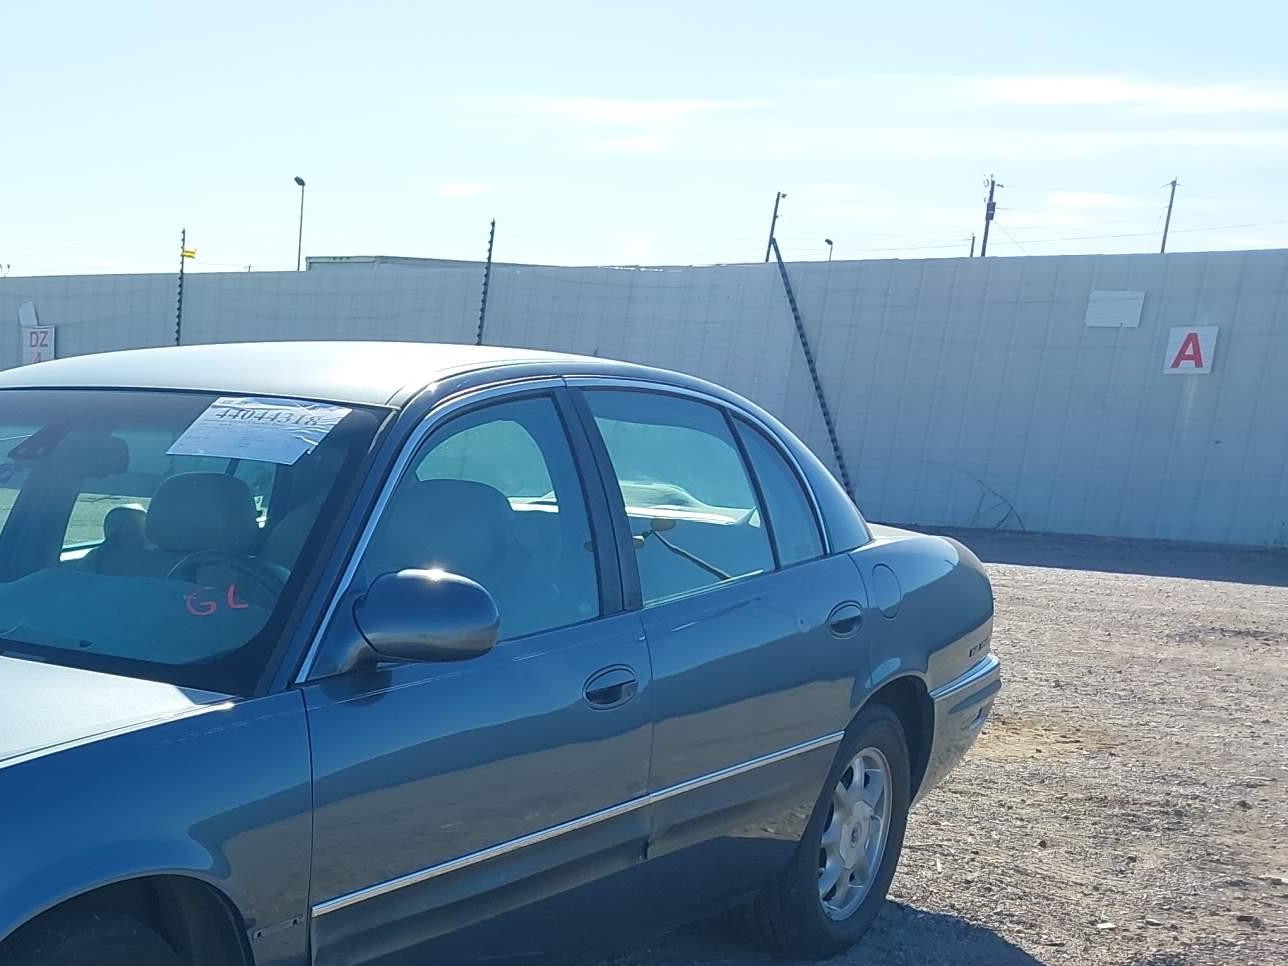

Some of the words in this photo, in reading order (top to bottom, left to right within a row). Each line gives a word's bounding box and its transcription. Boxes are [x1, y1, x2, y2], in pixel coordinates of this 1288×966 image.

[29, 330, 49, 348] DZ
[1170, 331, 1204, 369] A
[215, 407, 323, 427] 44044318
